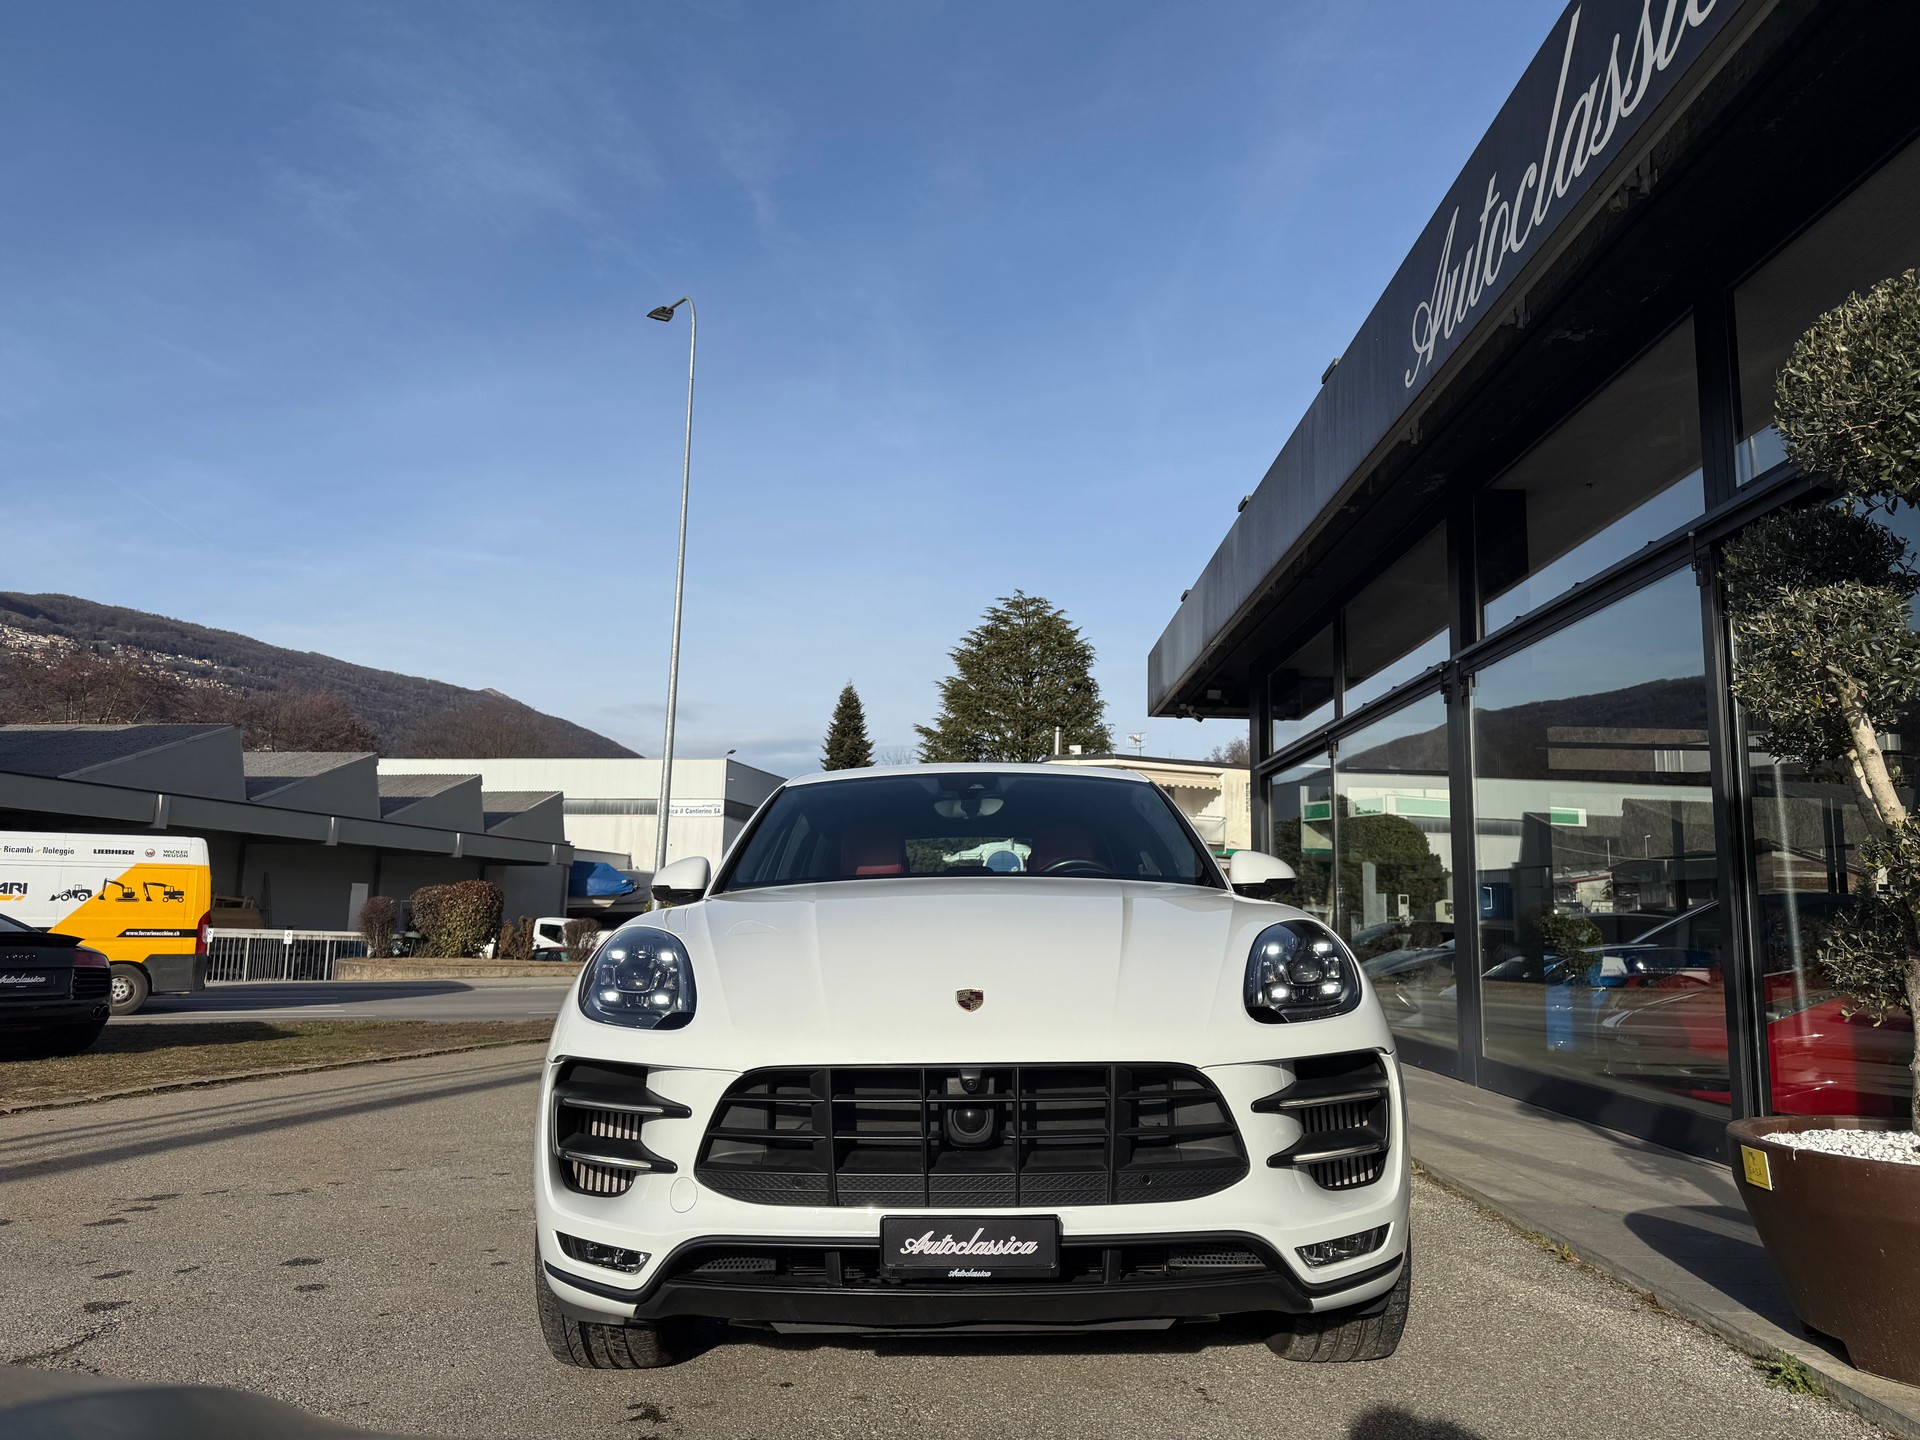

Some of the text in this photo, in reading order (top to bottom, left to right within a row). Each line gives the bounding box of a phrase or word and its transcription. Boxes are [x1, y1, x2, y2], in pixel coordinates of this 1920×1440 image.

[3, 845, 75, 857] Ricambi Noleggio
[93, 848, 135, 856] LIEBHERR
[900, 1227, 1038, 1255] Autoclassica
[948, 1268, 991, 1278] Autoclassica
